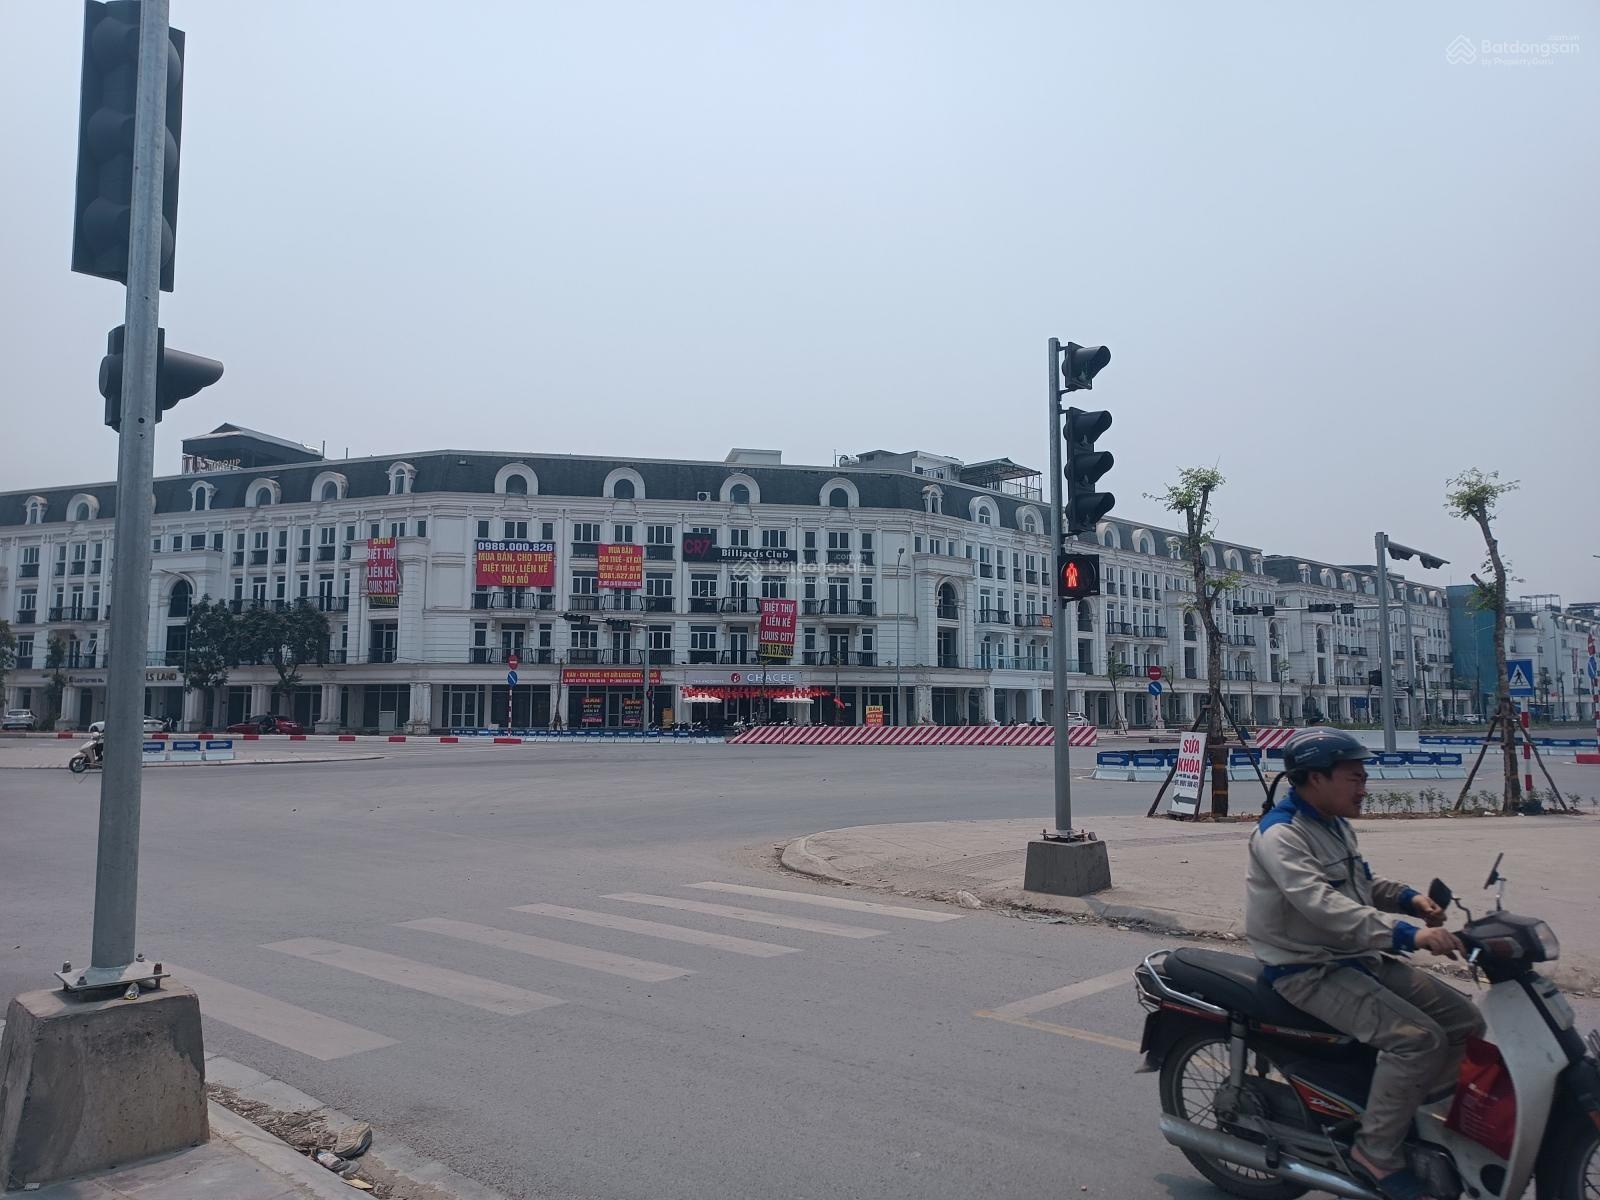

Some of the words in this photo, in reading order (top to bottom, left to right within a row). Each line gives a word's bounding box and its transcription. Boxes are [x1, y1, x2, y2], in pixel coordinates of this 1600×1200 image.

[478, 541, 553, 552] 0988.000.826
[684, 539, 711, 557] CR7
[478, 553, 495, 561] MUA
[517, 554, 532, 562] CHO
[534, 552, 553, 562] THUÊ
[721, 549, 763, 558] Billiards
[765, 550, 789, 559] Club
[764, 601, 780, 614] BIỆT
[760, 630, 779, 641] LOUIS
[780, 632, 795, 642] CITY
[157, 672, 177, 681] LAND
[747, 673, 795, 682] CHACEE
[1177, 756, 1200, 774] KHÓA
